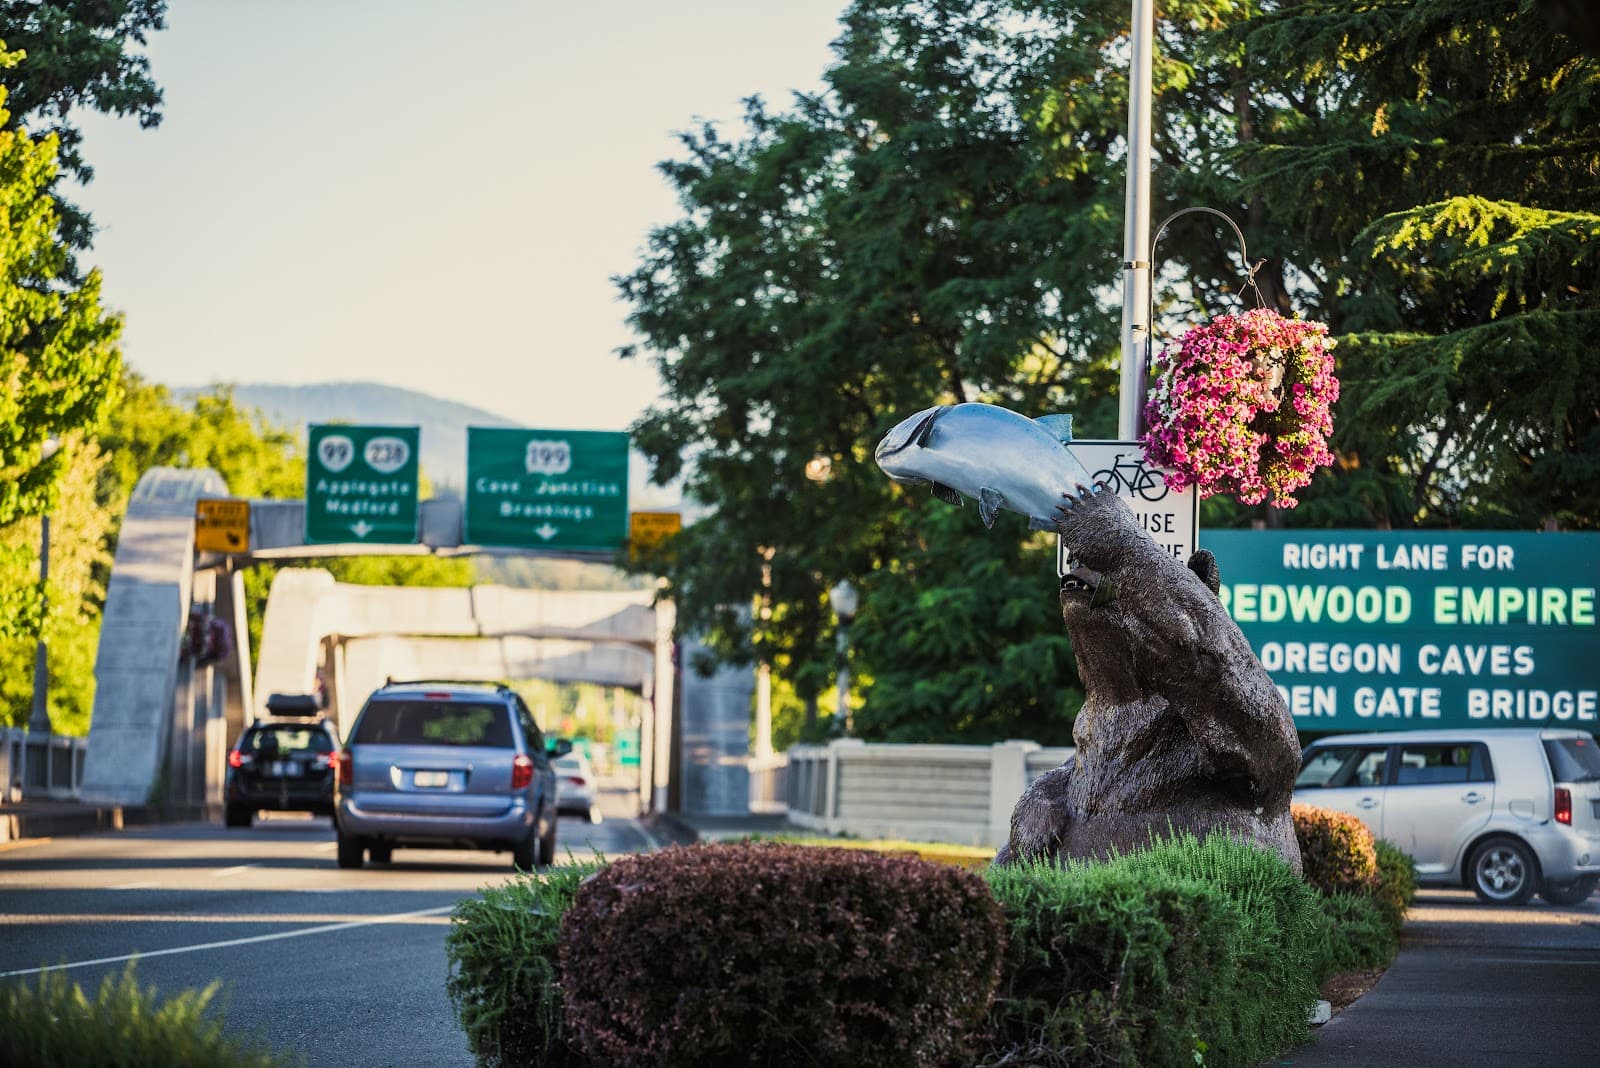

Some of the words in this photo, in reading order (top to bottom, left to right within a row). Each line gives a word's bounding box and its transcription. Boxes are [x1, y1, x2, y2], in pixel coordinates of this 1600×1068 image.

[323, 441, 349, 461] 99
[370, 443, 404, 463] 238
[530, 446, 566, 466] 199
[316, 478, 410, 498] Applegate
[476, 477, 520, 494] Cave
[535, 480, 620, 496] Junction
[325, 499, 399, 516] Medford
[500, 501, 594, 521] Brookings
[1283, 543, 1364, 570] RIGHT
[1376, 544, 1449, 570] LANE
[1461, 544, 1515, 571] FOR
[1434, 585, 1596, 626] EMPIRE
[1261, 642, 1401, 675] OREGON
[1418, 644, 1535, 676] CAVES
[1353, 686, 1442, 718] GATE
[1468, 688, 1598, 721] BRIDGE
